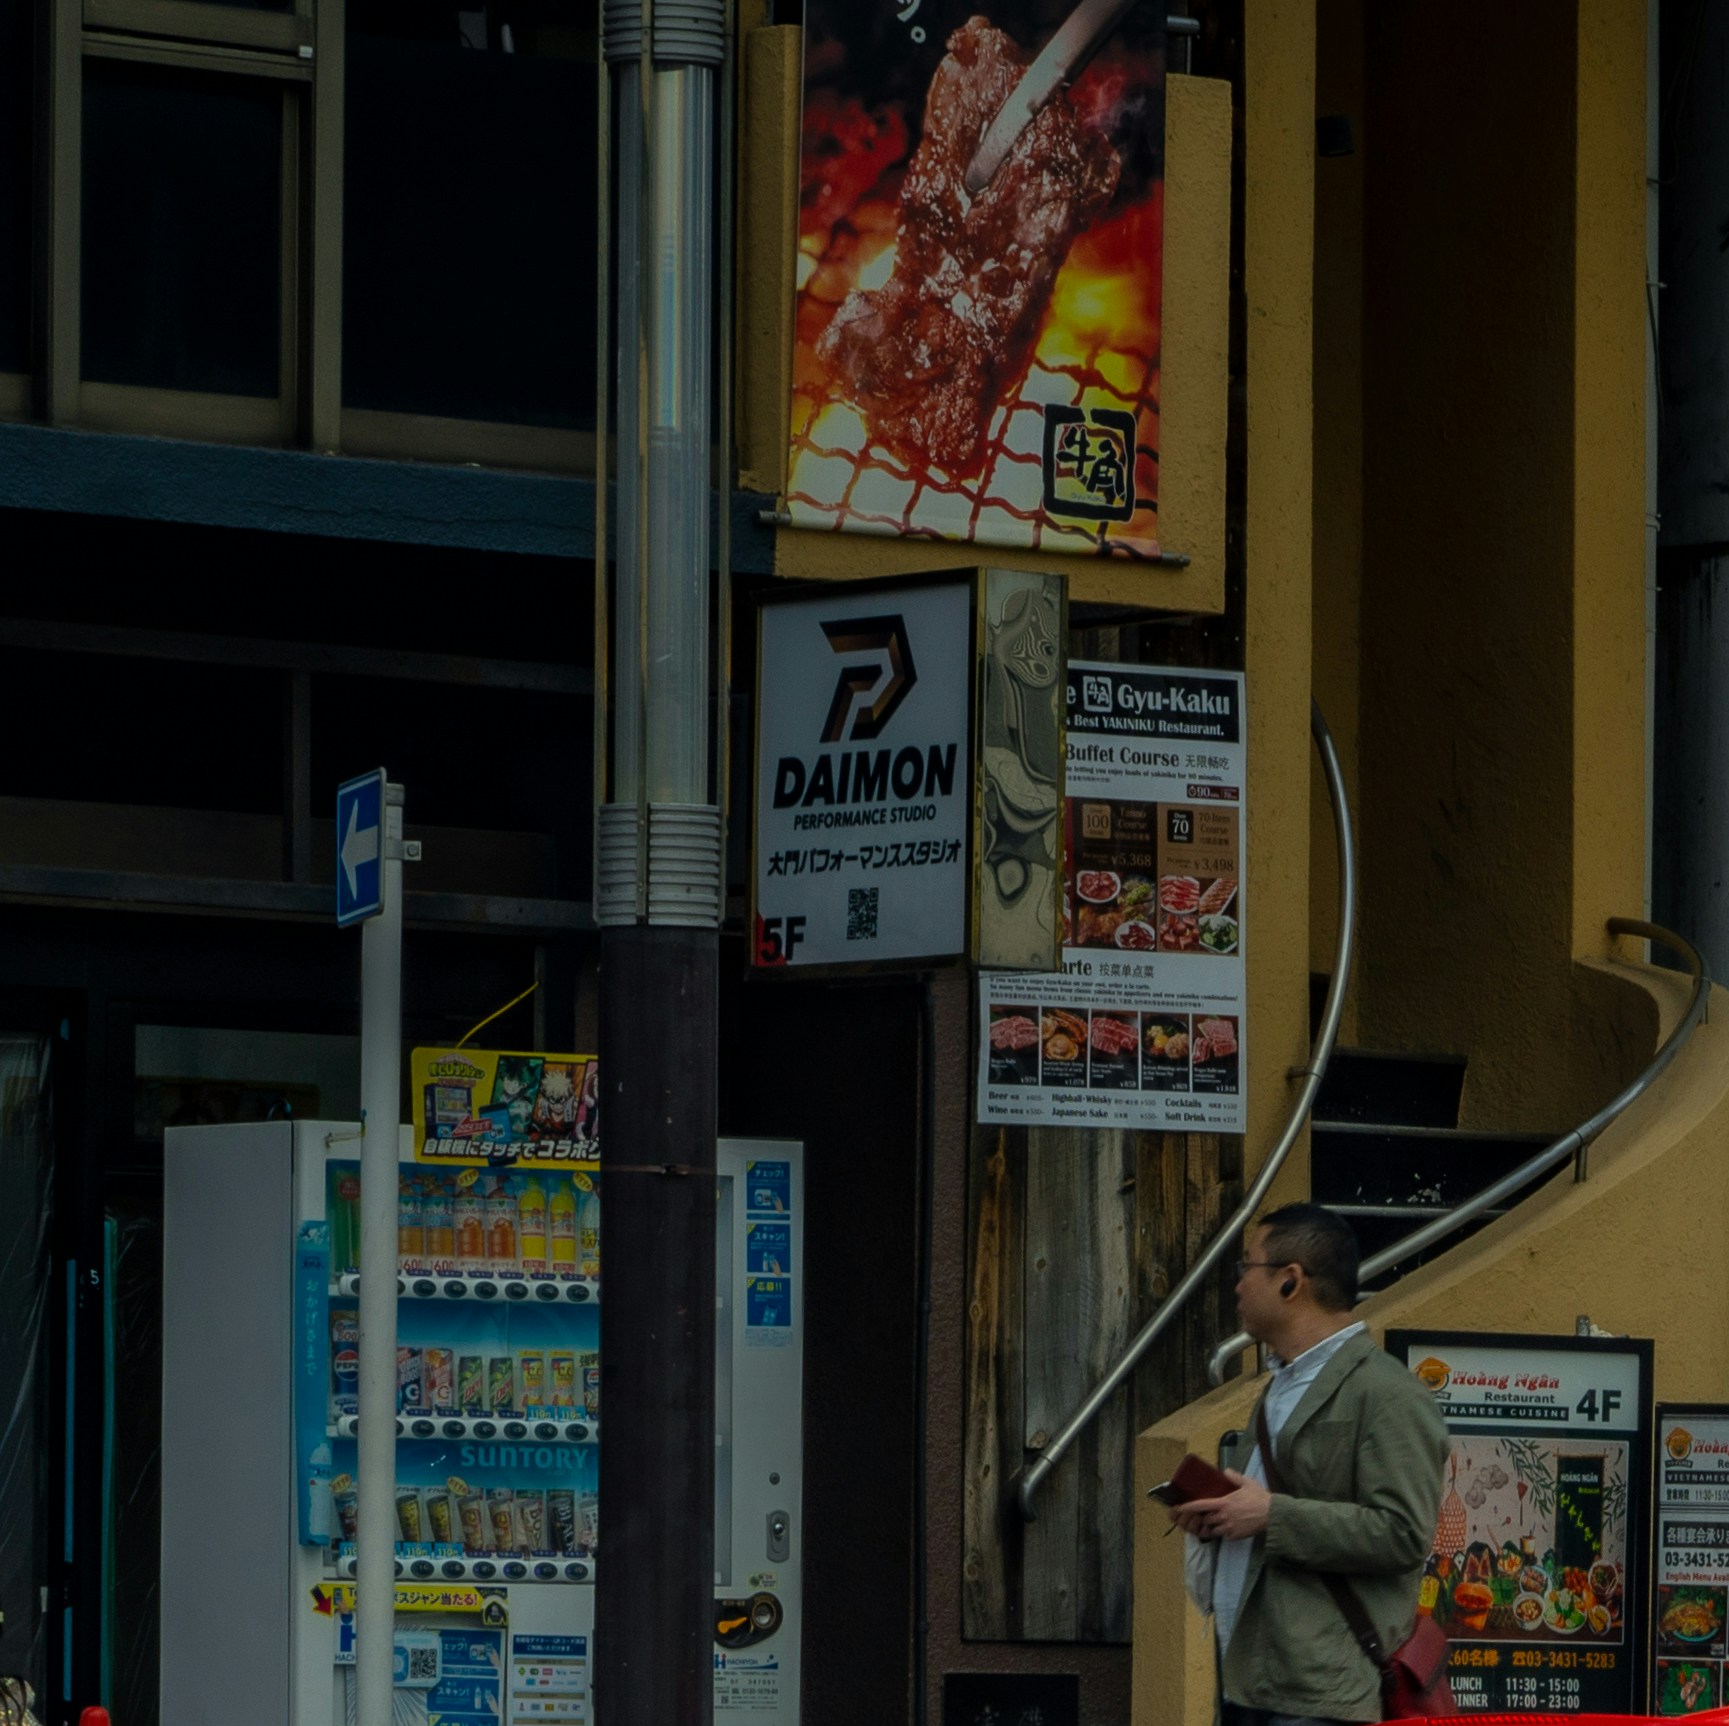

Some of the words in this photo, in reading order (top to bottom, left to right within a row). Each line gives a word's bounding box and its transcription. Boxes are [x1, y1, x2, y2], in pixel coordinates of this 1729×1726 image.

[1117, 683, 1231, 715] Gyu-Kaku
[1074, 714, 1100, 728] Best
[1102, 717, 1156, 732] YAKINIKU
[1158, 721, 1225, 737] Restaurant.
[1066, 743, 1114, 762] Buffet
[1120, 747, 1180, 767] Course
[773, 743, 957, 809] DAIMON
[793, 808, 887, 831] PERFORMANCE
[889, 804, 937, 823] STUDIO
[1172, 819, 1189, 834] 70
[767, 839, 961, 876] 大門パフォーマンススタジオ
[761, 916, 806, 962] 5F
[1060, 958, 1093, 976] arte
[1484, 1391, 1556, 1404] Restaurant
[1576, 1389, 1622, 1422] 4F
[1442, 1406, 1502, 1417] TNAMESE
[1509, 1408, 1567, 1419] CUISINE
[460, 1444, 589, 1469] SUNTORY
[1527, 1651, 1616, 1669] 03-3431-5283
[1450, 1676, 1482, 1691] LUNCH
[1506, 1676, 1537, 1691] 11:30
[1549, 1678, 1580, 1692] 15:00
[1506, 1694, 1537, 1708] 17:00
[1549, 1695, 1580, 1709] 23:00
